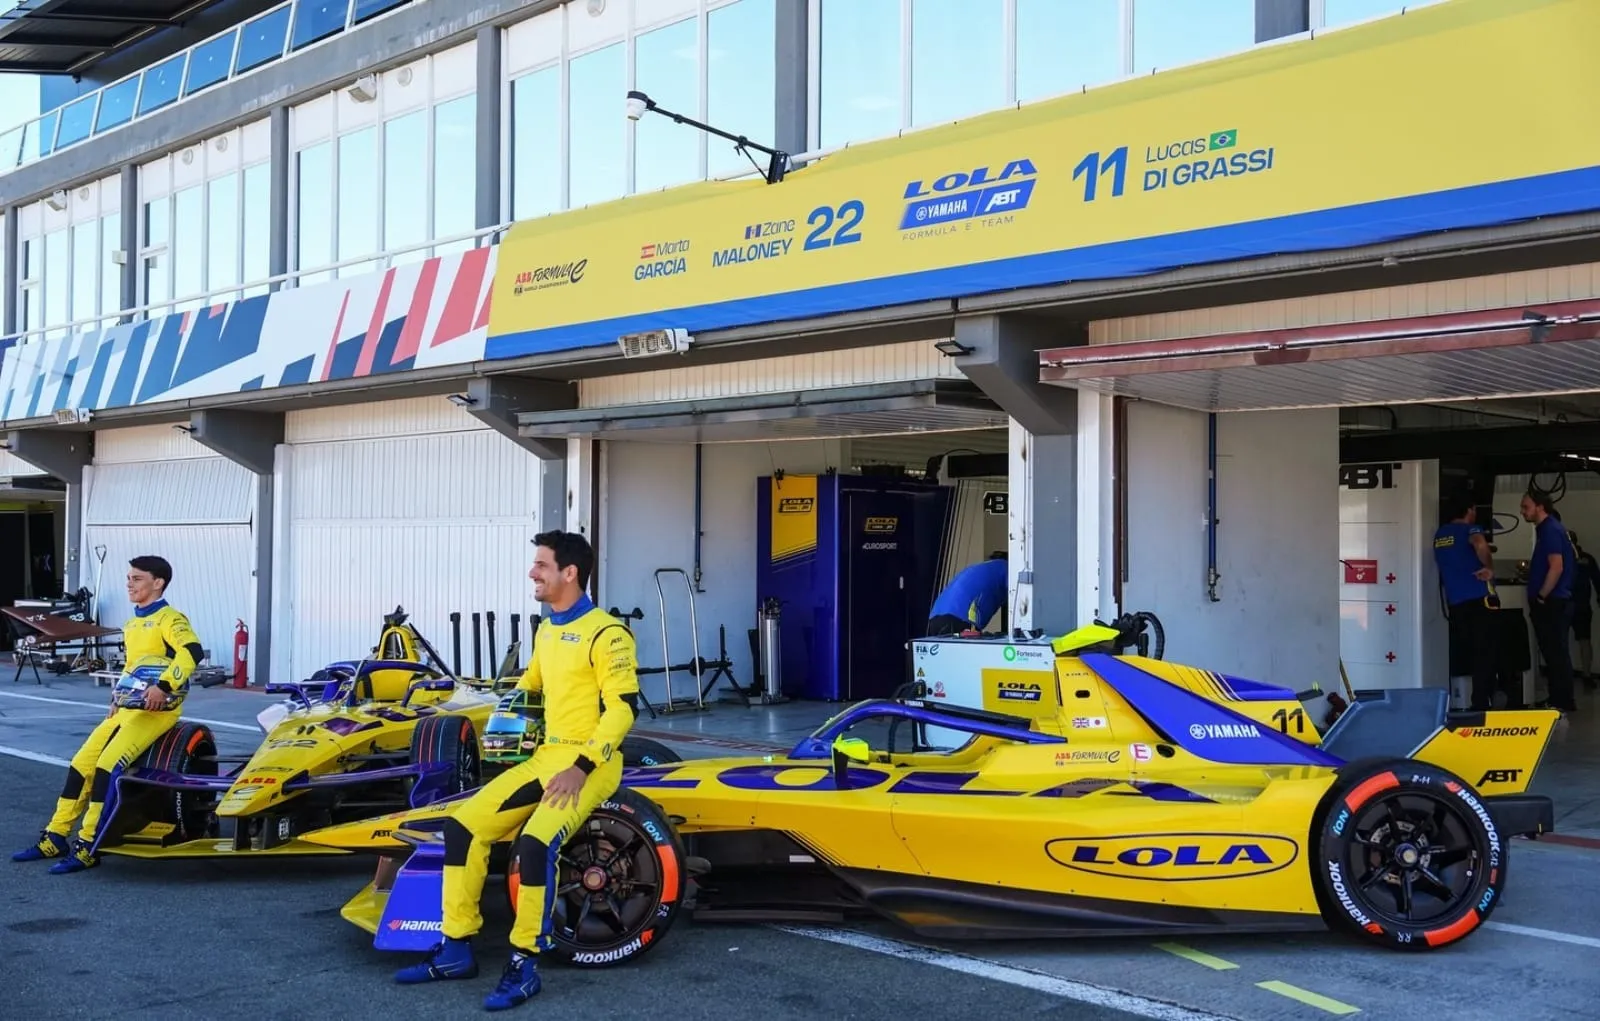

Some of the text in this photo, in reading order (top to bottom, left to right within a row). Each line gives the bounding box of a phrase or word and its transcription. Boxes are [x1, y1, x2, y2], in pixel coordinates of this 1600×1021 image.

[903, 158, 1038, 199] LOLA
[1072, 146, 1128, 202] 11
[1143, 147, 1274, 191] DI GRASSI
[928, 199, 967, 218] YAMAHA
[984, 189, 1021, 212] ABT
[763, 218, 795, 237] Zane
[803, 200, 865, 251] 22
[903, 215, 1015, 241] FORMULA E TEAM
[656, 239, 690, 257] Marta
[712, 238, 793, 268] MALONEY
[1339, 463, 1402, 489] ABT
[997, 681, 1041, 691] LOLA
[1206, 724, 1261, 739] YAMAHA
[1272, 708, 1304, 734] 11
[1071, 750, 1108, 761] FORMULA
[1133, 744, 1149, 760] E
[1476, 769, 1522, 787] ABT
[371, 830, 393, 840] ABT
[1072, 844, 1273, 867] LOLA
